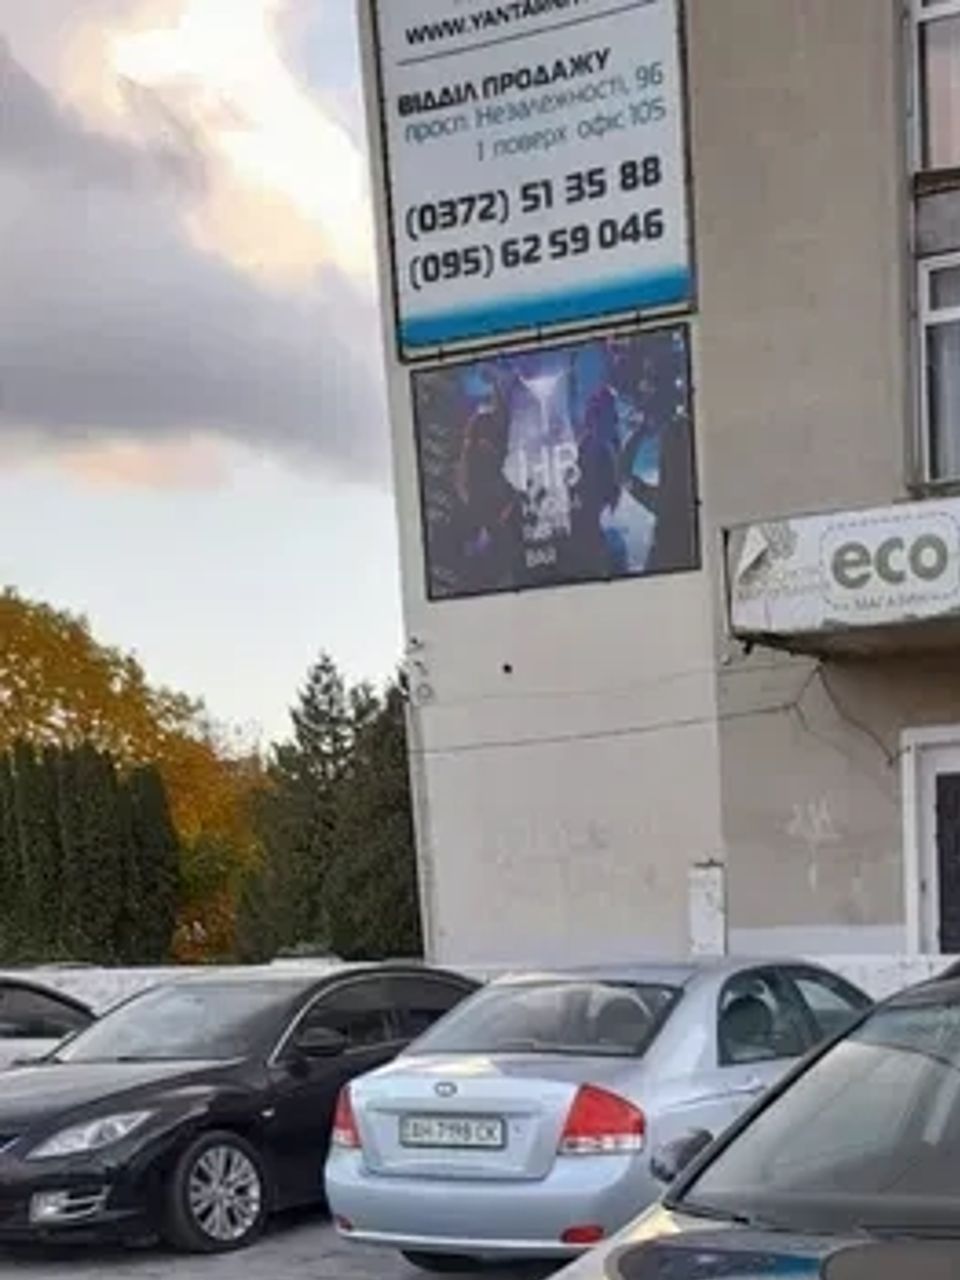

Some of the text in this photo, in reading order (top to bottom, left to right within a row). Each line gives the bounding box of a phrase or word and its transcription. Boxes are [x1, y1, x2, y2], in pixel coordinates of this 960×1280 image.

[398, 48, 611, 117] ВІДДІЛ ПРОДАЖУ
[635, 62, 664, 88] 96
[493, 126, 568, 157] поверх
[629, 98, 666, 127] 105
[405, 155, 662, 241] (0372) 51 35 88
[409, 208, 664, 290] (095) 62 59 046
[831, 533, 949, 589] eco
